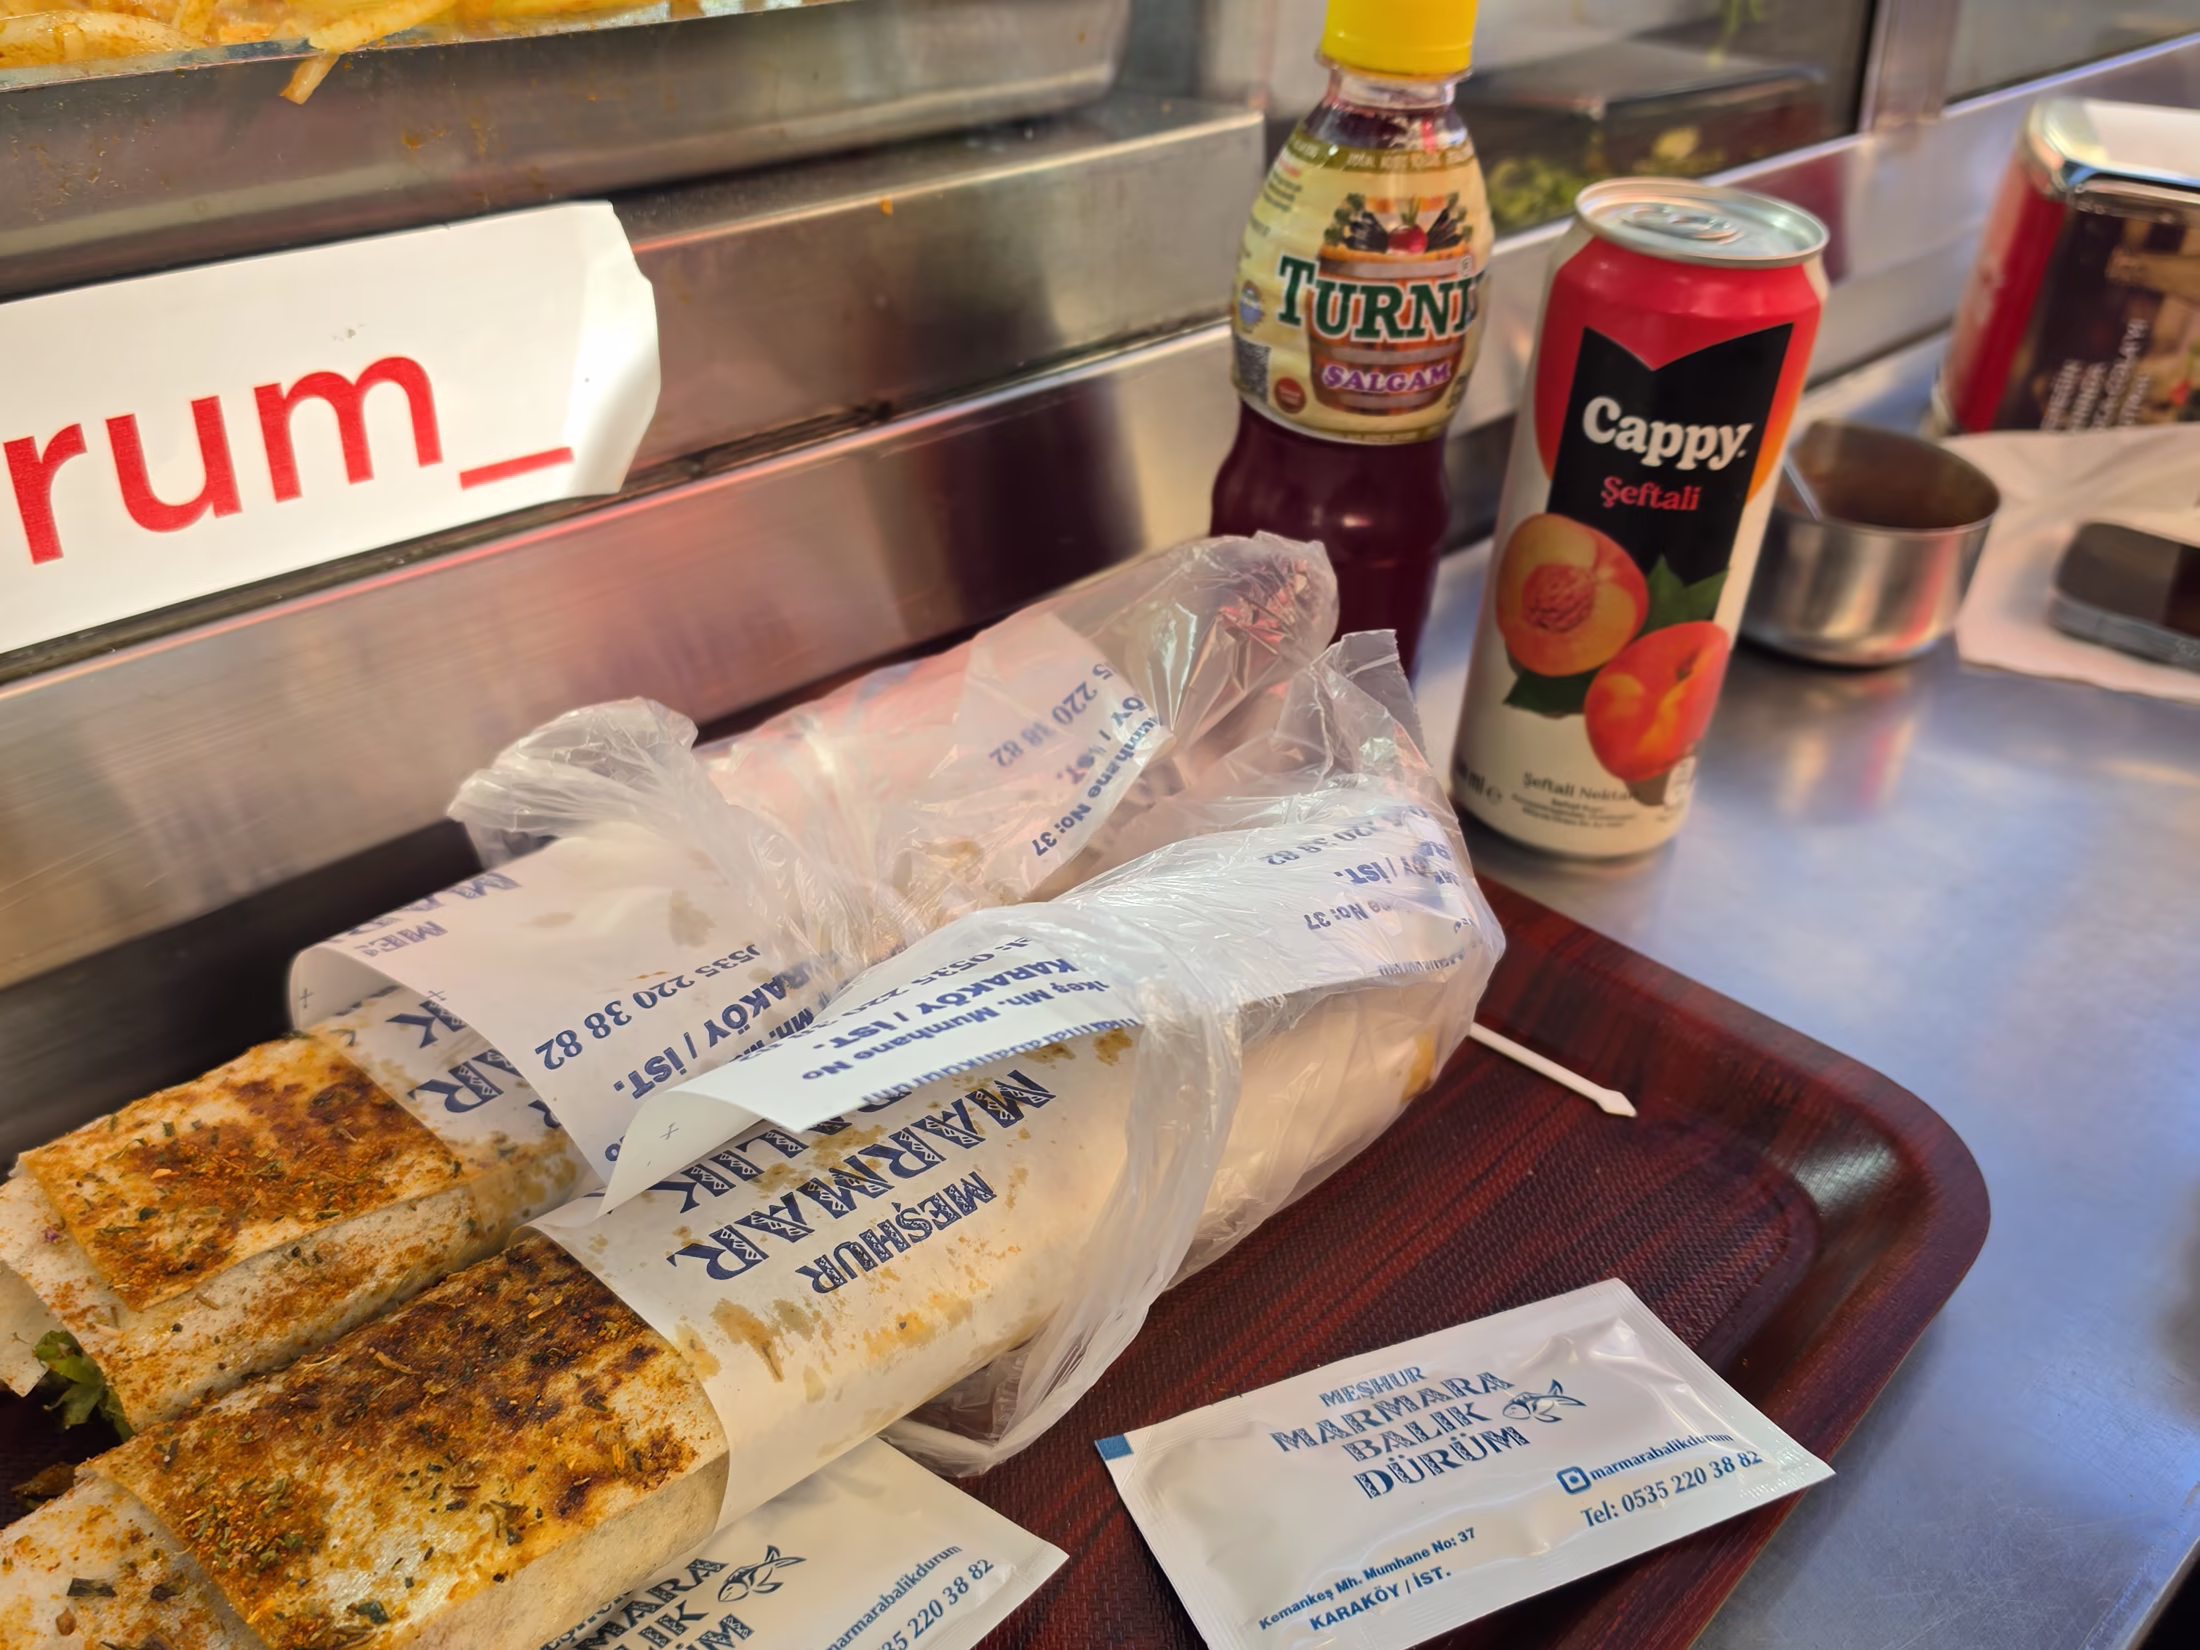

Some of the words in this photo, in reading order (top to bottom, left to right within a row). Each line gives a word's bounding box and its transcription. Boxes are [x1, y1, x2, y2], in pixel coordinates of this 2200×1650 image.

[1276, 254, 1484, 340] TURNI
[1583, 396, 1753, 471] Cappy
[1601, 476, 1701, 511] Şeftali
[1032, 831, 1057, 857] 37
[1054, 803, 1092, 834] No:
[1333, 861, 1392, 885] İST.
[1303, 911, 1332, 931] 37
[1330, 902, 1369, 921] No:
[632, 974, 696, 1010] 220
[918, 957, 1080, 1016] KARAKÖY
[997, 987, 1055, 1010] Mh.
[583, 999, 633, 1040] 38
[812, 1019, 892, 1051] İST.
[853, 1005, 1001, 1062] Mumhane
[534, 1029, 584, 1071] 82
[682, 1031, 698, 1060] /
[801, 1059, 855, 1081] No
[612, 1046, 688, 1100] İST.
[666, 1069, 1058, 1281] MARMAR
[795, 1171, 998, 1295] MEŞHUR
[1269, 1371, 1516, 1452] MARMARA
[1318, 1366, 1428, 1408] MEŞHUR
[1341, 1402, 1493, 1463] BALIK
[1589, 1432, 1735, 1481] marmarabalikdurum
[1353, 1426, 1531, 1500] DÜRÜM
[1580, 1500, 1619, 1528] Tel:
[1621, 1480, 1670, 1513] 0535
[1670, 1466, 1708, 1495] 220
[1709, 1455, 1736, 1479] 38
[1737, 1450, 1764, 1469] 82
[573, 1557, 730, 1650] MARA
[906, 1598, 944, 1640] 220
[942, 1576, 969, 1606] 38
[968, 1558, 995, 1581] 82
[1258, 1588, 1335, 1631] Kemankeş
[1334, 1575, 1363, 1594] Mh.
[1362, 1547, 1431, 1581] Mumhane
[1431, 1537, 1458, 1554] No:
[1457, 1526, 1476, 1544] 37
[1309, 1583, 1401, 1632] KARAKÖY
[1404, 1579, 1412, 1594] /
[1411, 1565, 1452, 1589] İST.
